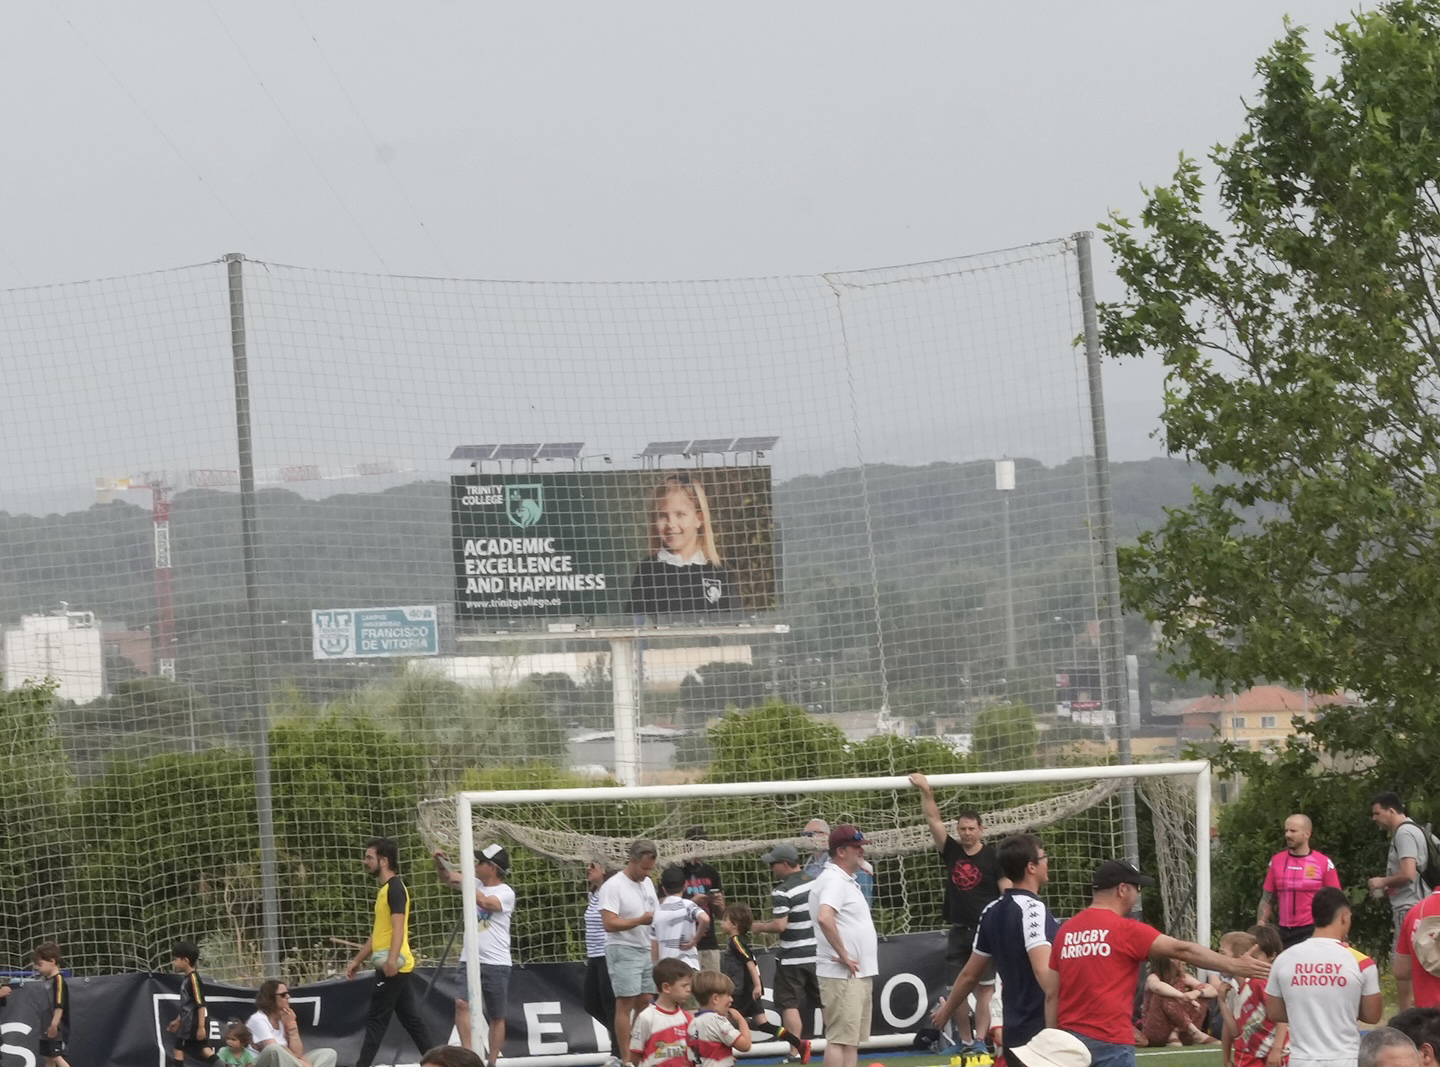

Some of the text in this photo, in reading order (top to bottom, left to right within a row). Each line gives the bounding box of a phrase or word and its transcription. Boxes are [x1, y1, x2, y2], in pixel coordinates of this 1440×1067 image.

[465, 485, 503, 495] TRINITY
[462, 495, 503, 506] COLLEGE
[464, 537, 555, 556] ACADEMIC
[465, 555, 572, 575] EXCELLENCE
[465, 573, 606, 594] AND HAPPINESS
[361, 626, 428, 639] FRANCISCO
[362, 639, 428, 650] DE VITORIA
[1064, 929, 1109, 945] RUGBY
[1061, 942, 1111, 960] ARROYO
[1295, 963, 1343, 975] RUGBY
[1291, 975, 1348, 987] ARROYO
